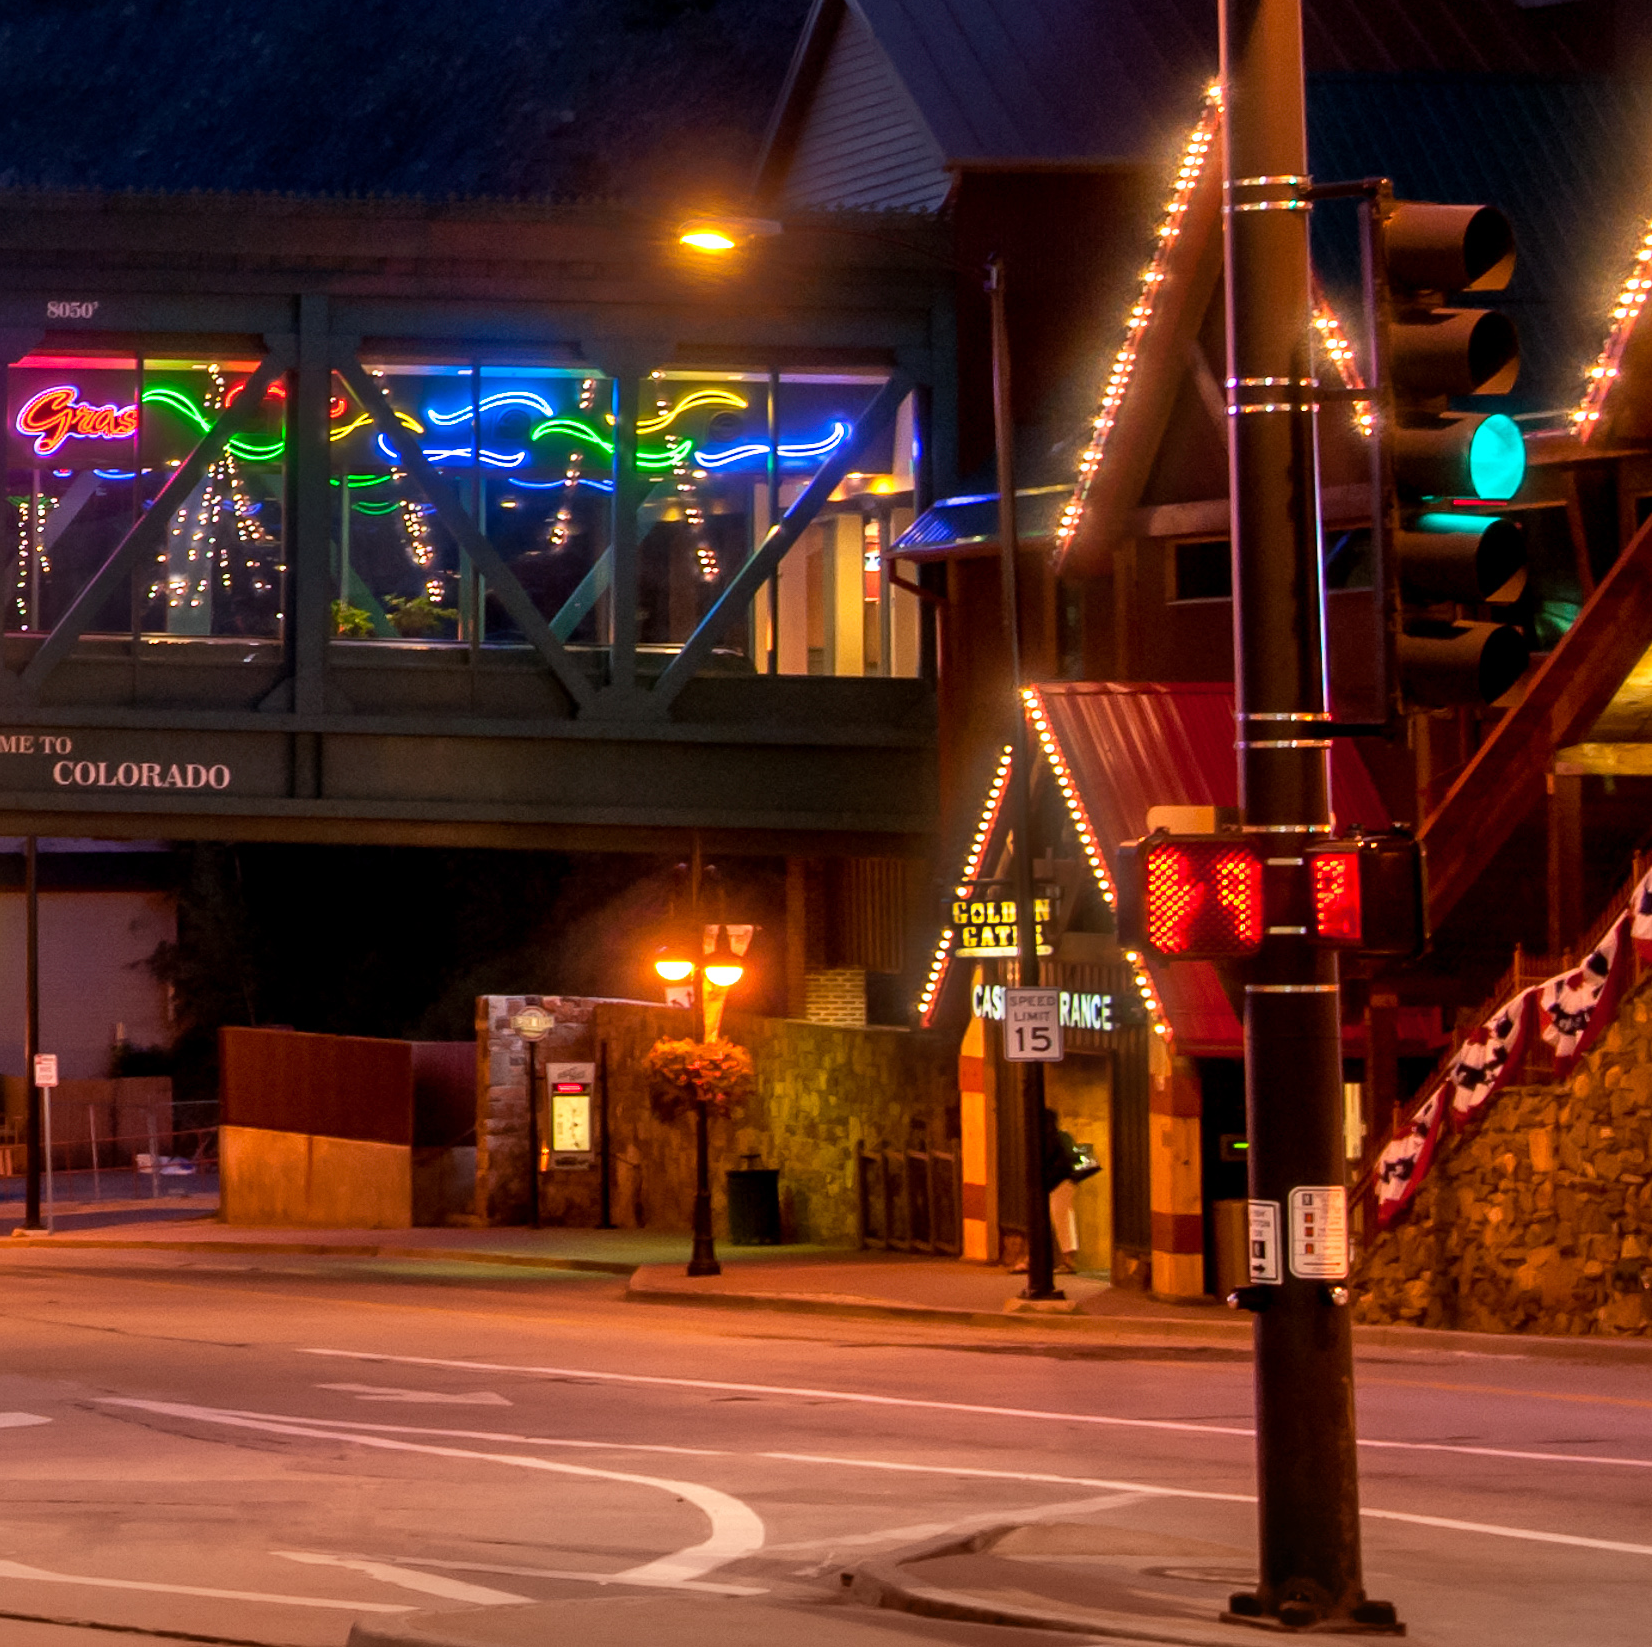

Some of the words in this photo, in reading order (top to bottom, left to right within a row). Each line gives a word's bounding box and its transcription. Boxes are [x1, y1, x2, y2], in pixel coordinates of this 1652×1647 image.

[16, 385, 139, 456] Gras
[38, 735, 73, 755] TO
[52, 760, 232, 790] COLORADO
[952, 898, 1050, 924] GOLDN
[1009, 995, 1057, 1007] SPEED
[1014, 1010, 1051, 1023] LIMIT
[1014, 1026, 1052, 1052] 15
